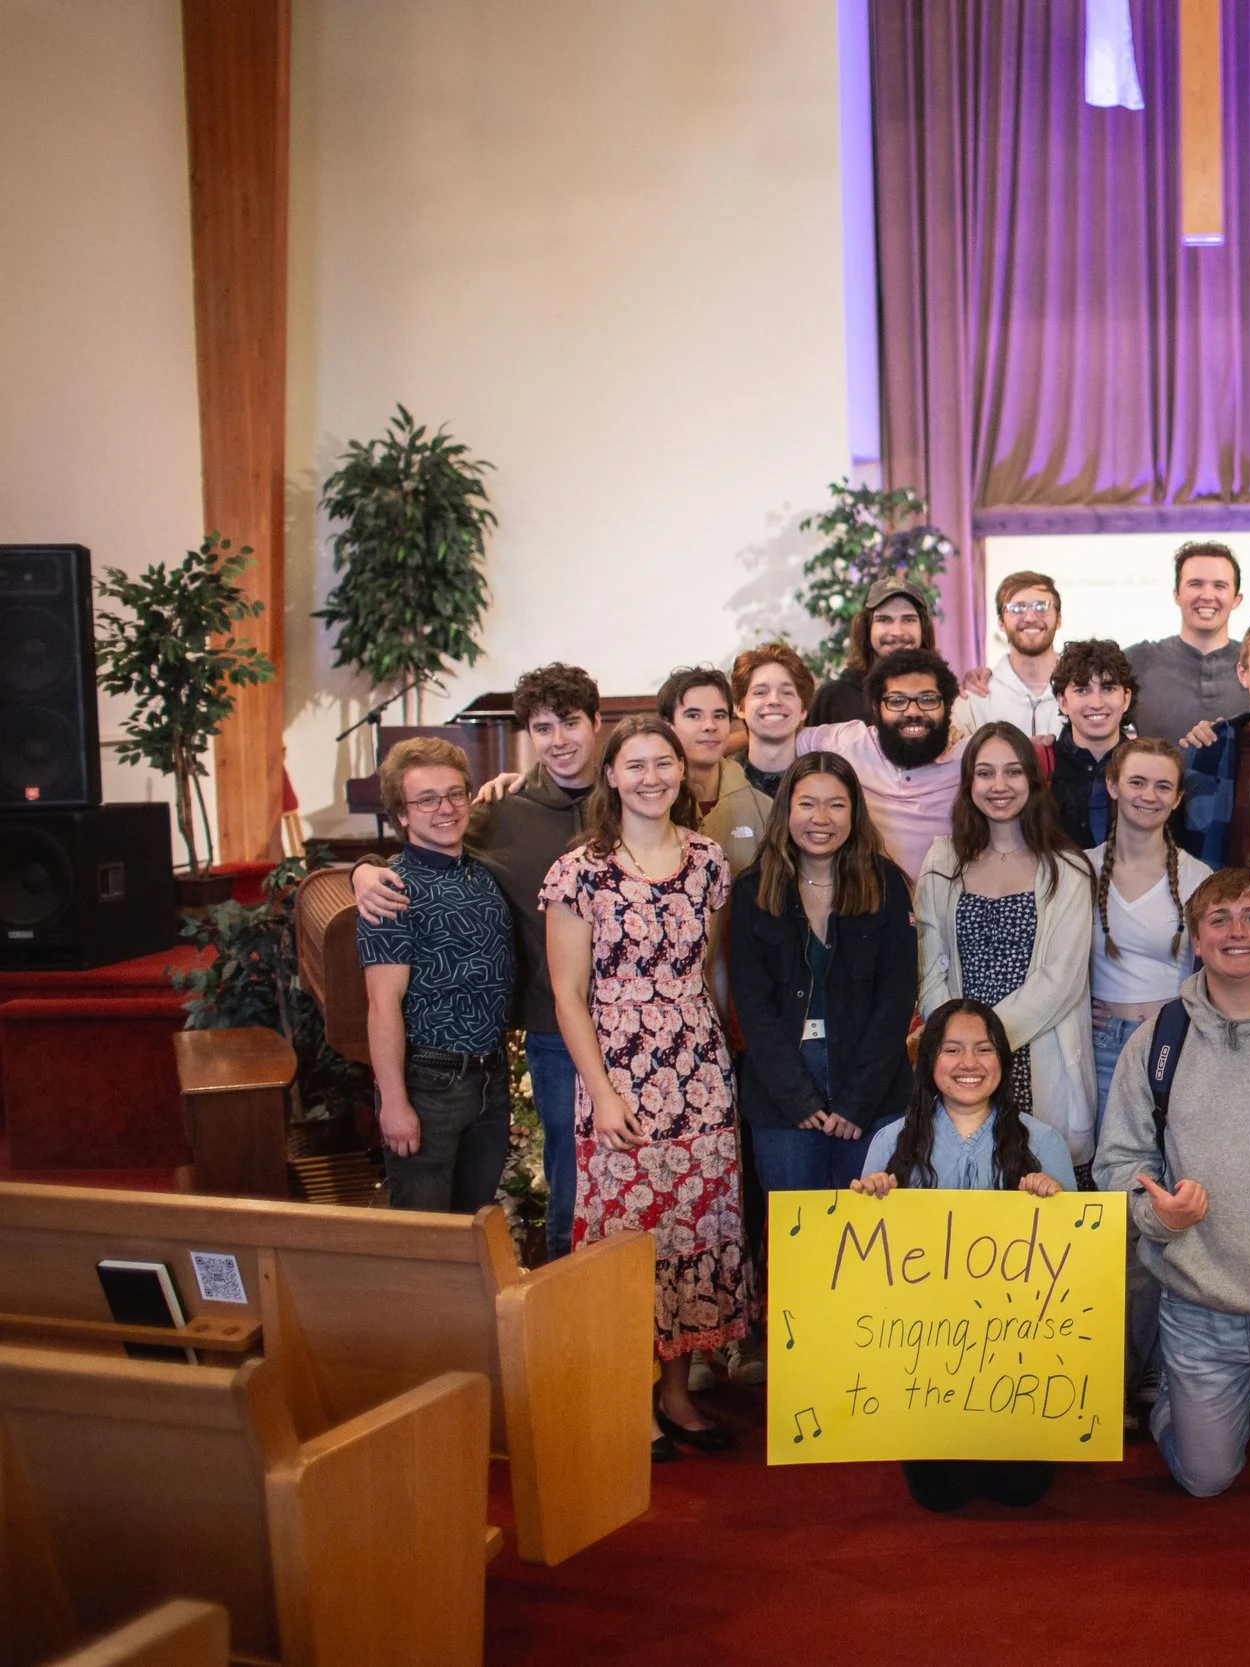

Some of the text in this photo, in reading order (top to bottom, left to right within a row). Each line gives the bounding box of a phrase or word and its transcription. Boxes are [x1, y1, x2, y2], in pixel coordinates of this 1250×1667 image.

[1155, 1045, 1170, 1080] OGIO
[830, 1207, 1072, 1322] Melody
[854, 1314, 1075, 1375] singing praise
[846, 1373, 1088, 1420] to the LORD!
